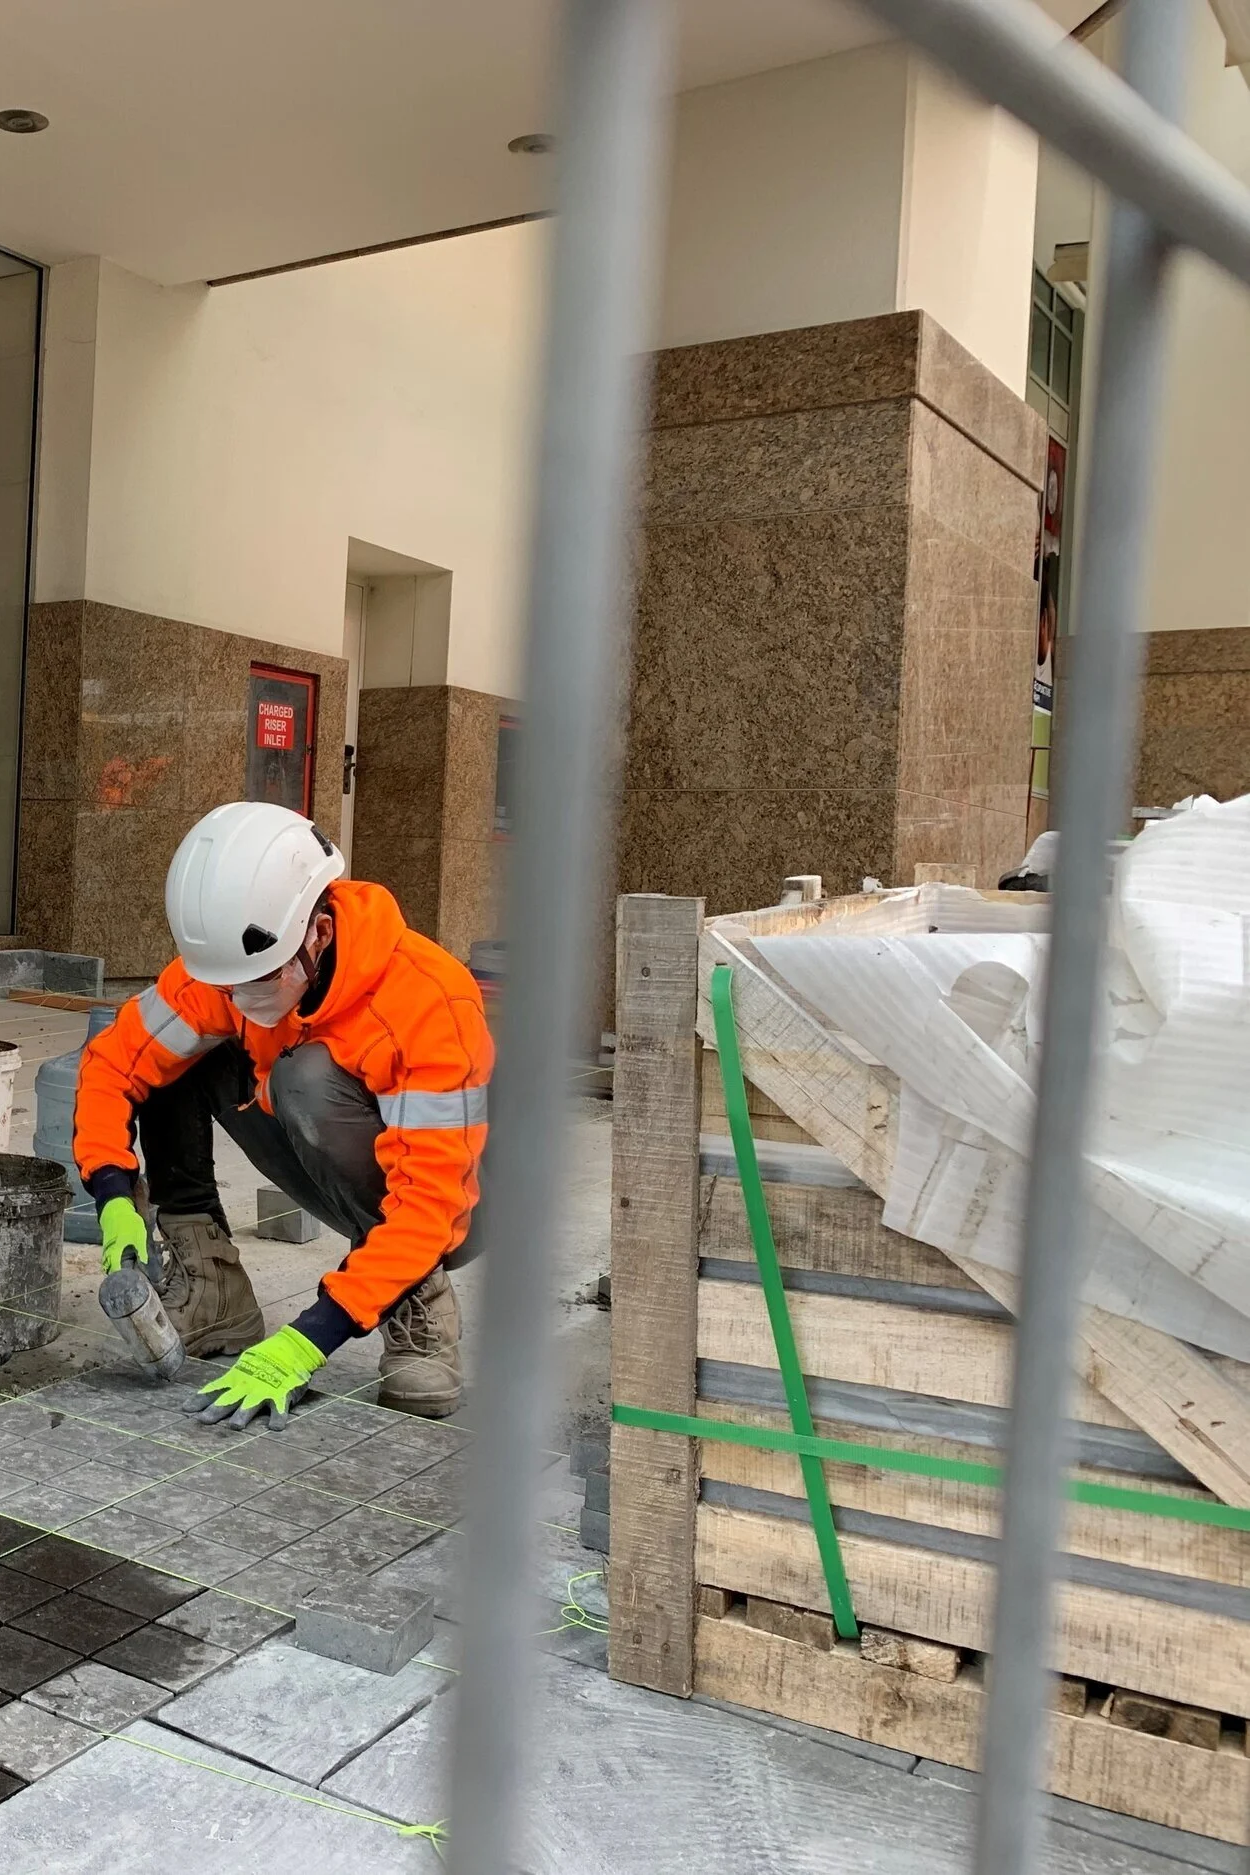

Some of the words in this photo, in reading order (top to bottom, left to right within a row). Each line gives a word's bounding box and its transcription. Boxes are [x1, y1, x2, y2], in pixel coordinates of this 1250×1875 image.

[258, 703, 294, 719] CHARGED
[264, 718, 287, 732] RISER
[264, 733, 286, 747] INLET
